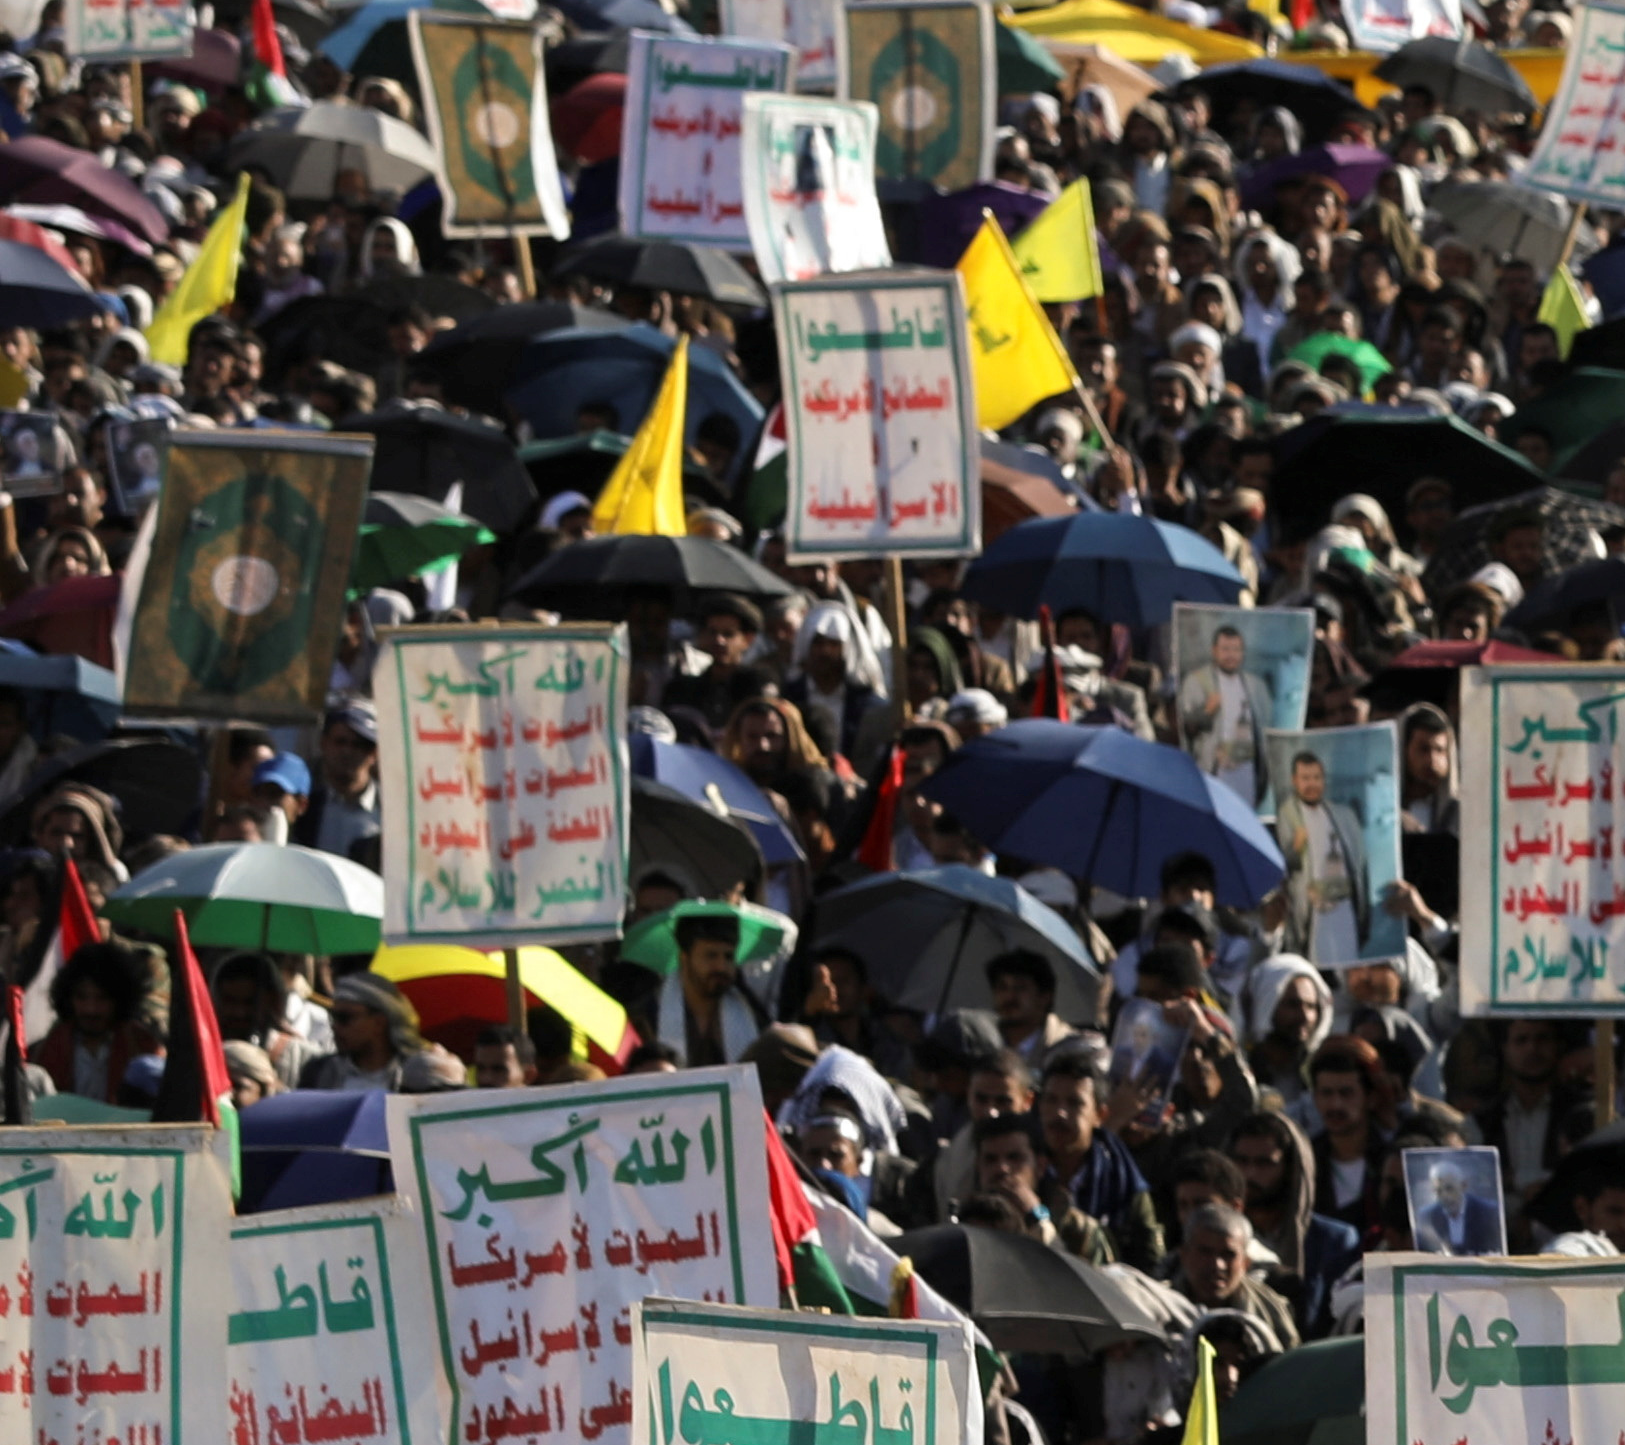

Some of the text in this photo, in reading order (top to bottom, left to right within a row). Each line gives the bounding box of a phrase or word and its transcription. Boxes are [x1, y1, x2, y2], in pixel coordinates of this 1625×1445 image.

[794, 306, 947, 363] قاطعوا
[1506, 765, 1612, 807] لأمريكا
[1504, 825, 1612, 865] لإسرائيل
[1503, 883, 1579, 923] اليهود
[1504, 935, 1609, 997] للإسلام
[442, 1113, 716, 1228] الله أكبر
[63, 1176, 164, 1239] الله
[443, 1212, 721, 1290] الموت لأمريكا
[47, 1271, 162, 1326] الموت
[461, 1303, 601, 1377] لإسرائيل
[47, 1349, 161, 1404] الموت
